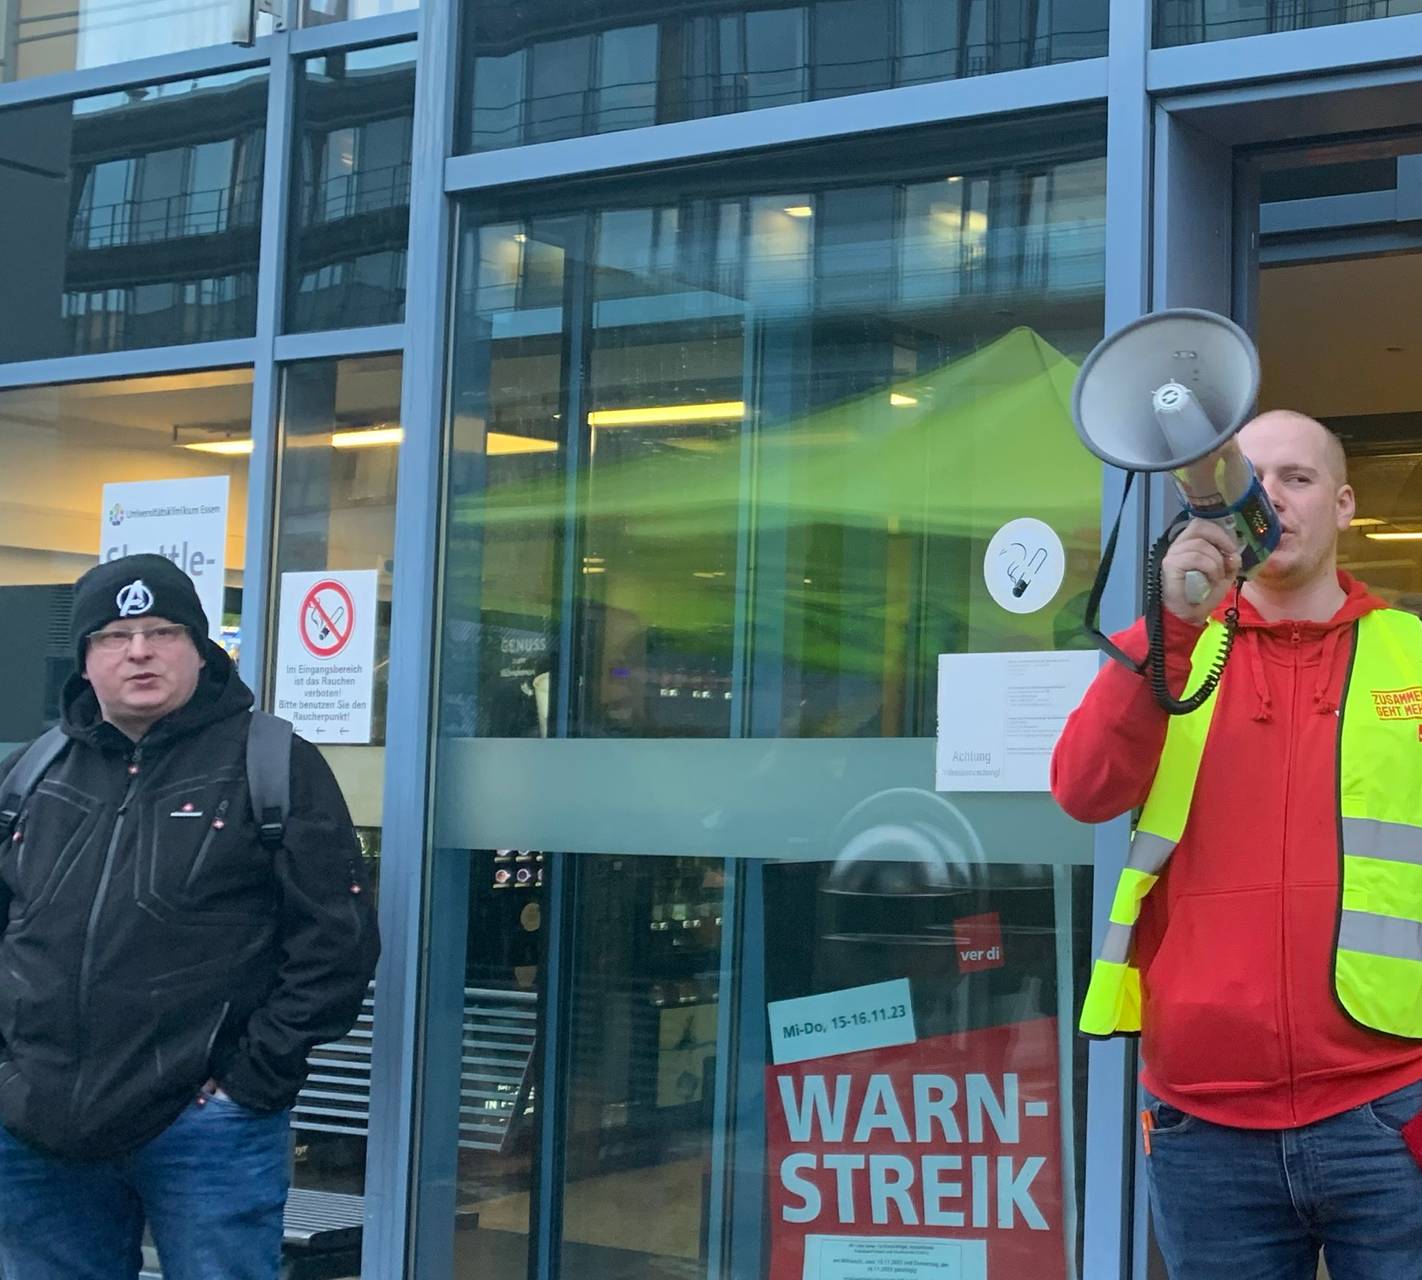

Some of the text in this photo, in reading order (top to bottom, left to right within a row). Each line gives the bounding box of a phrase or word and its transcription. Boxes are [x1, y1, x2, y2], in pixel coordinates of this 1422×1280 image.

[286, 664, 363, 675] Im Eingangsbereich
[294, 676, 356, 686] ist das Rauchen
[304, 688, 342, 697] verboten!
[278, 699, 367, 709] Bitte benutzen Sie den
[293, 711, 351, 722] Raucherpunkt!
[1376, 706, 1402, 717] GEHT
[783, 1004, 907, 1039] Mi-Do, 15-16.11.23
[777, 1073, 1049, 1144] WARN-
[780, 1152, 1050, 1231] STREIK
